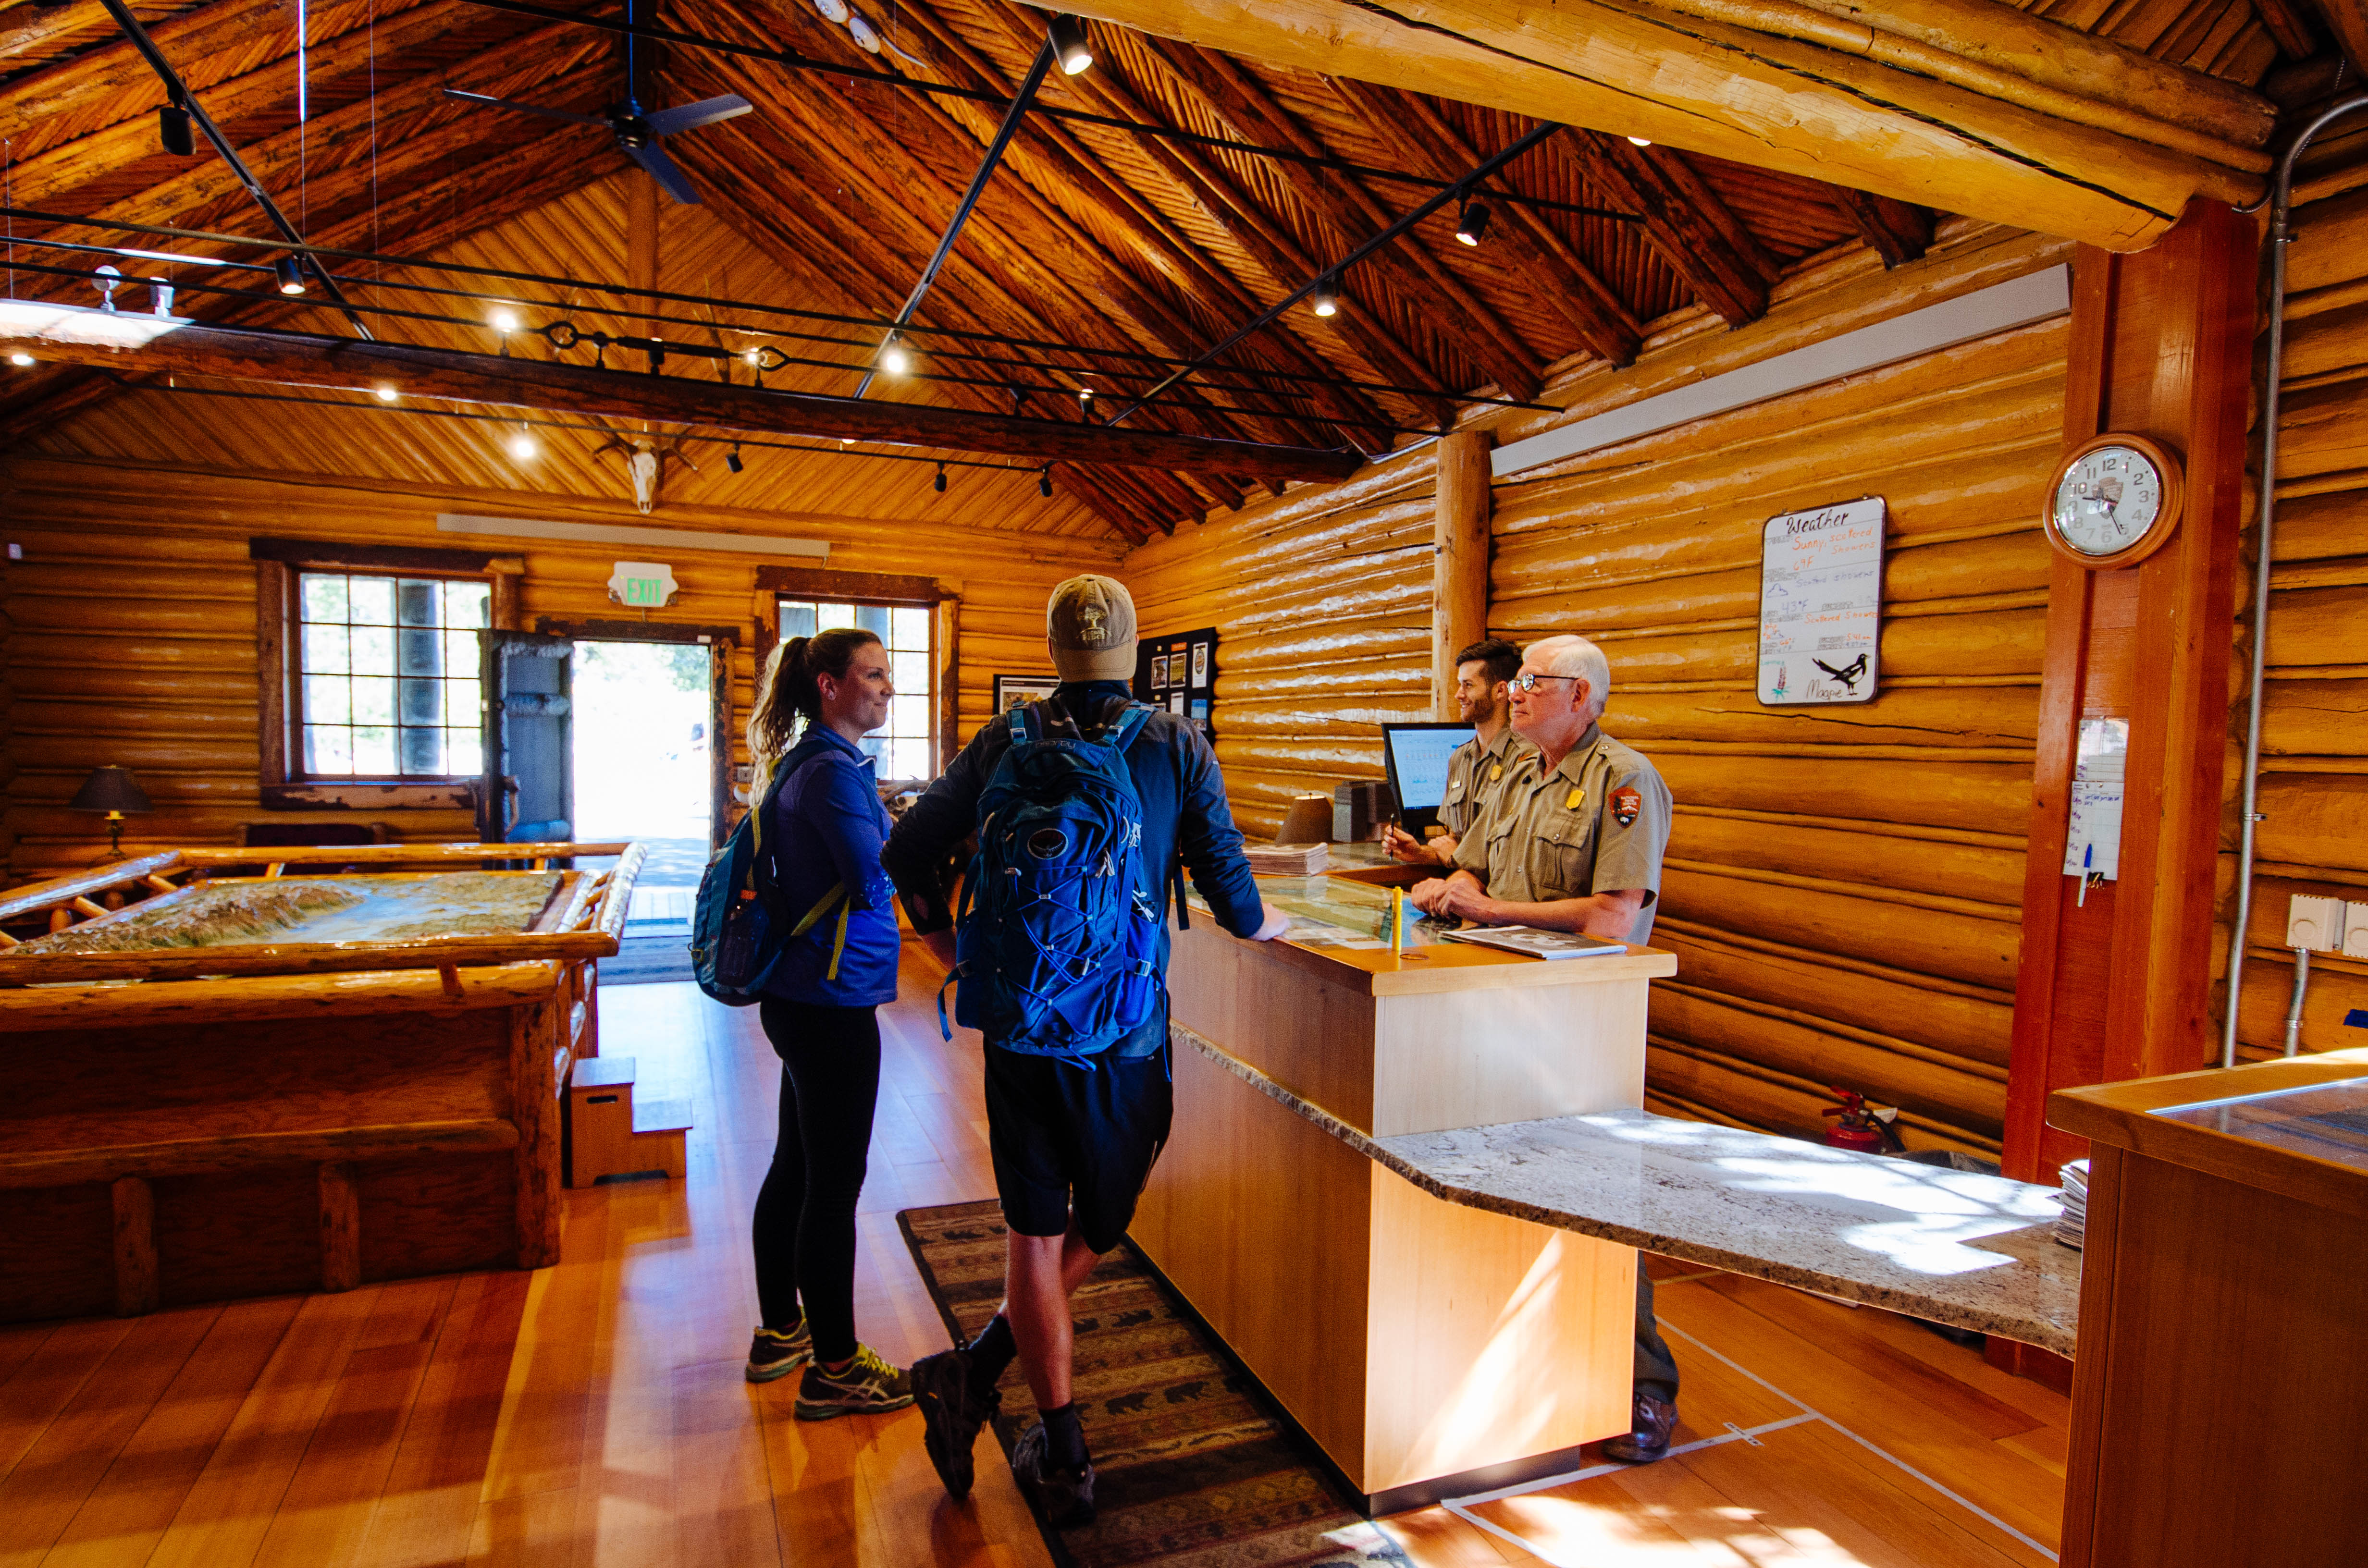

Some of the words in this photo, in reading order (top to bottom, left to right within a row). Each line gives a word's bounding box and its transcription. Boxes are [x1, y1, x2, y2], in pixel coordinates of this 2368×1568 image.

[2102, 459, 2116, 472] 12
[2087, 467, 2096, 479] 11
[2134, 473, 2144, 486] 2
[2072, 482, 2087, 494] 10
[2138, 490, 2149, 503] 3
[2132, 509, 2142, 520] 4
[1787, 509, 1849, 534] Weather
[2073, 517, 2084, 529] 8
[2086, 527, 2096, 540] 7
[2101, 530, 2112, 543] 6
[2120, 524, 2129, 536] 5
[627, 577, 663, 604] EXIT
[1806, 679, 1843, 701] Magpie
